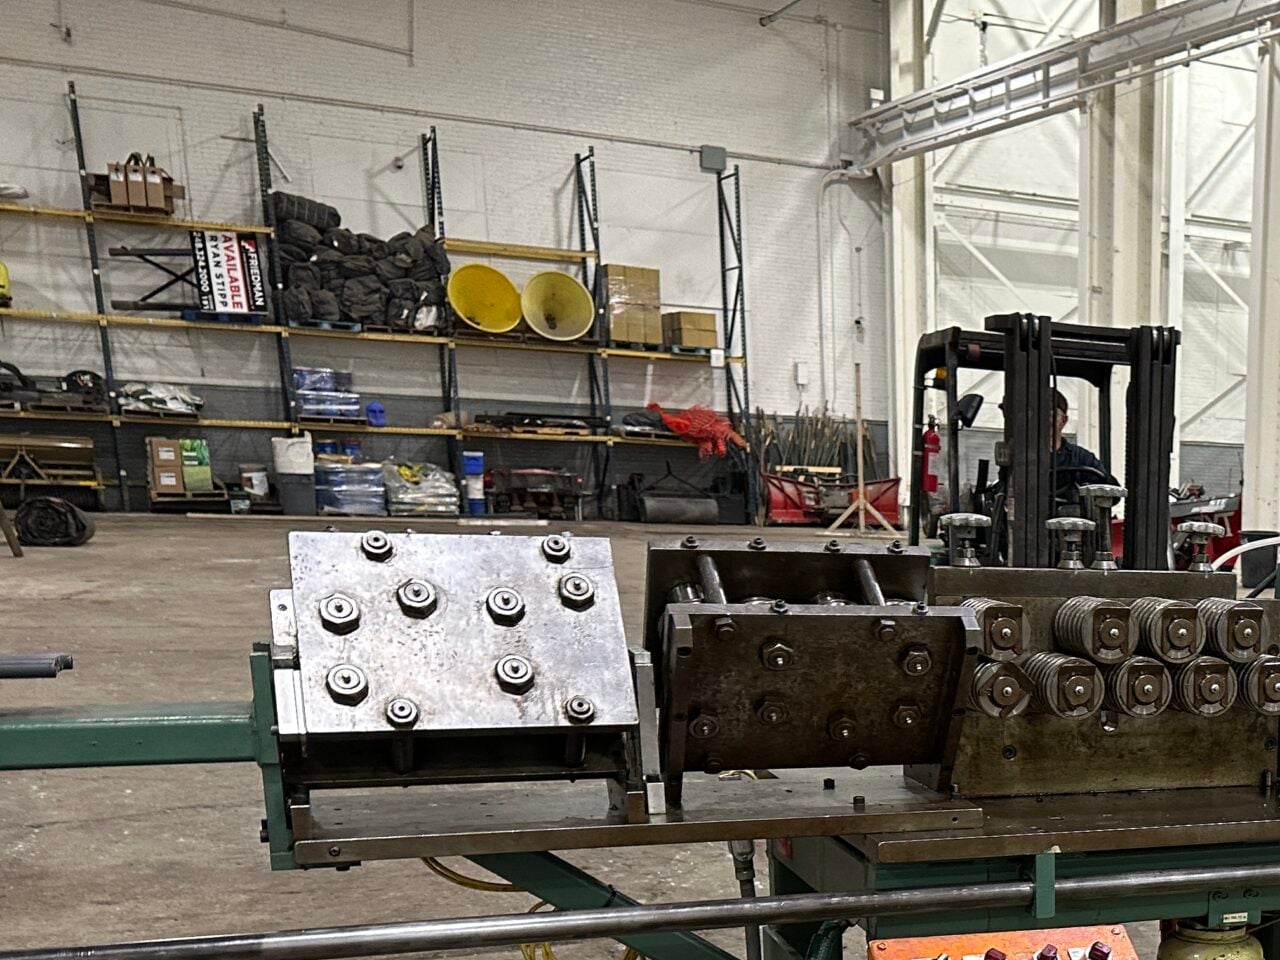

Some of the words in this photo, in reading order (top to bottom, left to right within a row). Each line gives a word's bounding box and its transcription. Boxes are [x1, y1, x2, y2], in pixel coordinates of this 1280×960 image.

[209, 235, 222, 268] RYAN
[222, 234, 243, 309] AVAILABLE
[215, 273, 228, 307] STIPP
[248, 253, 265, 306] FRIEDMAN
